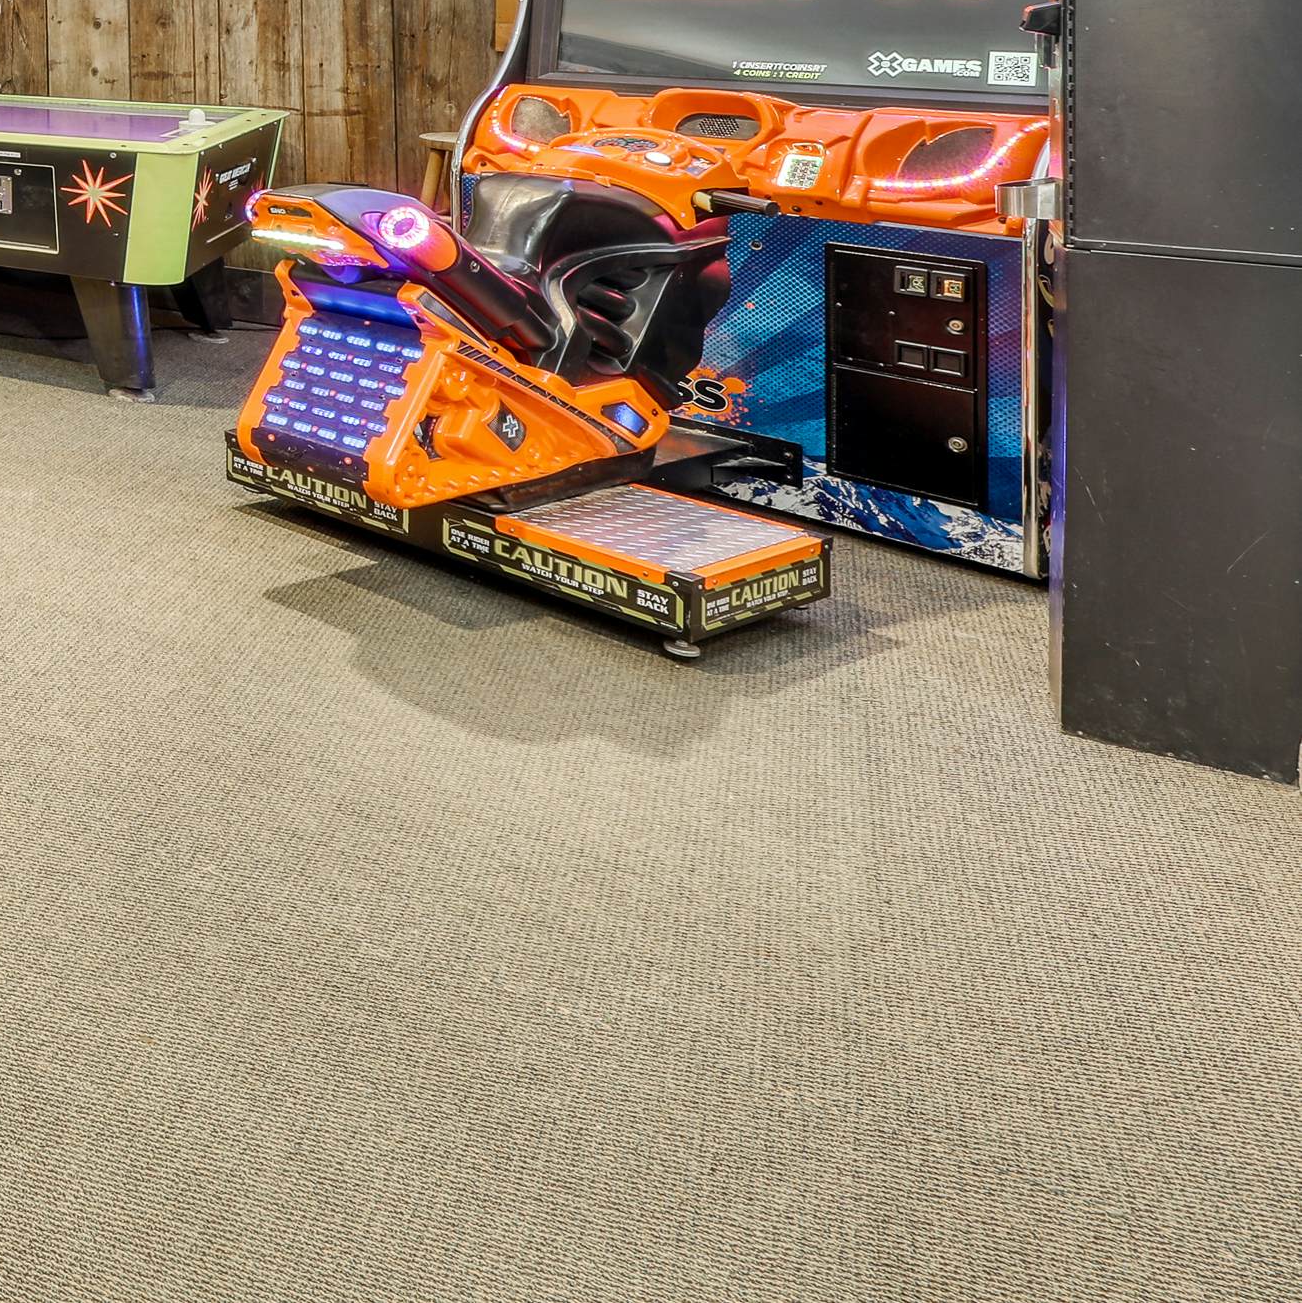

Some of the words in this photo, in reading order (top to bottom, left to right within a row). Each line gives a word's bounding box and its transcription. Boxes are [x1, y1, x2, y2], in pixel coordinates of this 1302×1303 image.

[742, 69, 771, 77] COINS
[786, 71, 821, 79] CREDIT
[901, 58, 983, 74] GAMES
[233, 462, 242, 471] AT
[249, 467, 263, 477] TIME
[234, 456, 245, 465] ONE
[246, 458, 264, 471] RIDER
[266, 465, 367, 509] CAUTION
[287, 483, 311, 496] WATCH
[312, 491, 331, 503] YOUR
[332, 498, 350, 509] STEP
[374, 501, 397, 513] STAY
[374, 507, 398, 522] BACK
[450, 528, 466, 539] ONE
[467, 533, 490, 547] RIDER
[450, 535, 462, 544] AT
[472, 540, 490, 554] TIME
[494, 538, 628, 599] CAUTION
[802, 567, 817, 576] STAY
[521, 562, 553, 579] WATCH
[554, 573, 579, 588] YOUR
[582, 582, 604, 596] STEP
[802, 575, 817, 585] BACK
[731, 569, 799, 607] CAUTION
[637, 588, 669, 605] STAY
[706, 600, 716, 609] ONE
[716, 596, 730, 606] RIDER
[746, 598, 763, 608] WATCH
[764, 593, 776, 603] YOUR
[777, 589, 789, 598] STEP
[636, 598, 669, 615] BACK
[706, 609, 713, 617] AT
[718, 604, 730, 613] TIME
